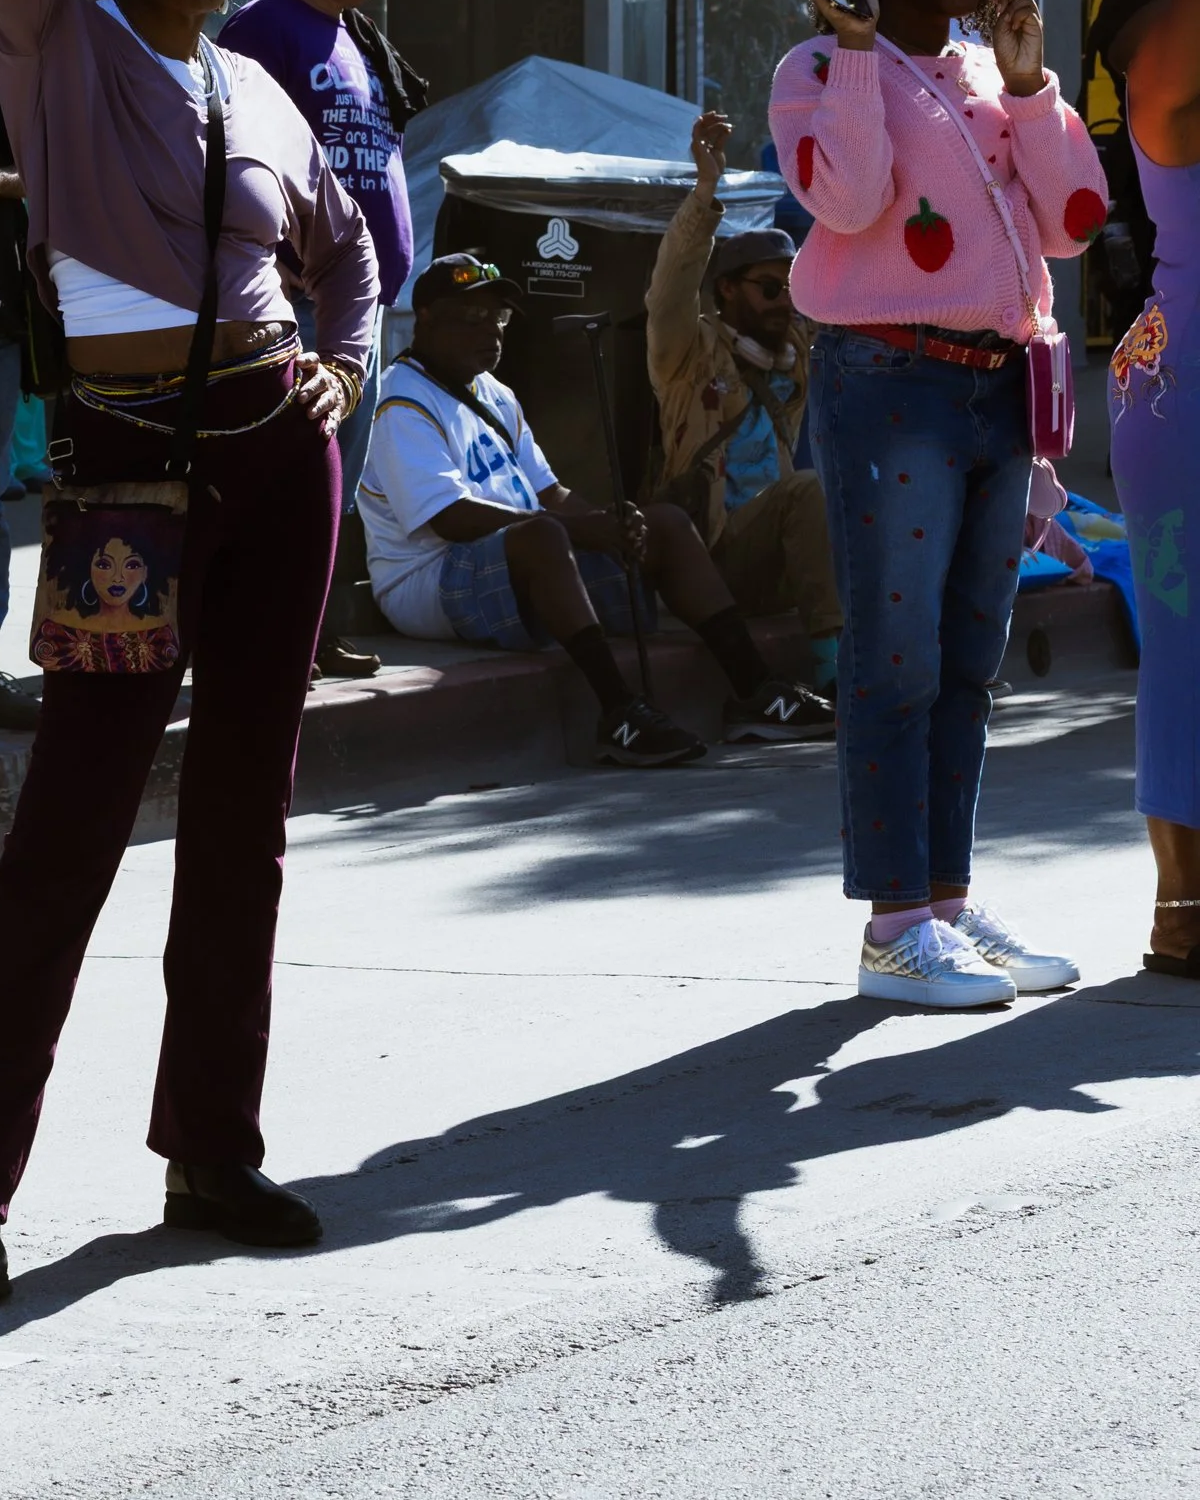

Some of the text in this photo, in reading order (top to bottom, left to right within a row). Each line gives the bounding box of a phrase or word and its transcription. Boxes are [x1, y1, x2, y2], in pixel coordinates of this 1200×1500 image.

[335, 94, 353, 106] JUST
[322, 109, 348, 123] THE
[345, 131, 368, 145] are
[322, 145, 350, 169] ND
[338, 174, 355, 189] et
[361, 175, 375, 190] in
[764, 695, 800, 722] N
[612, 720, 641, 749] N
